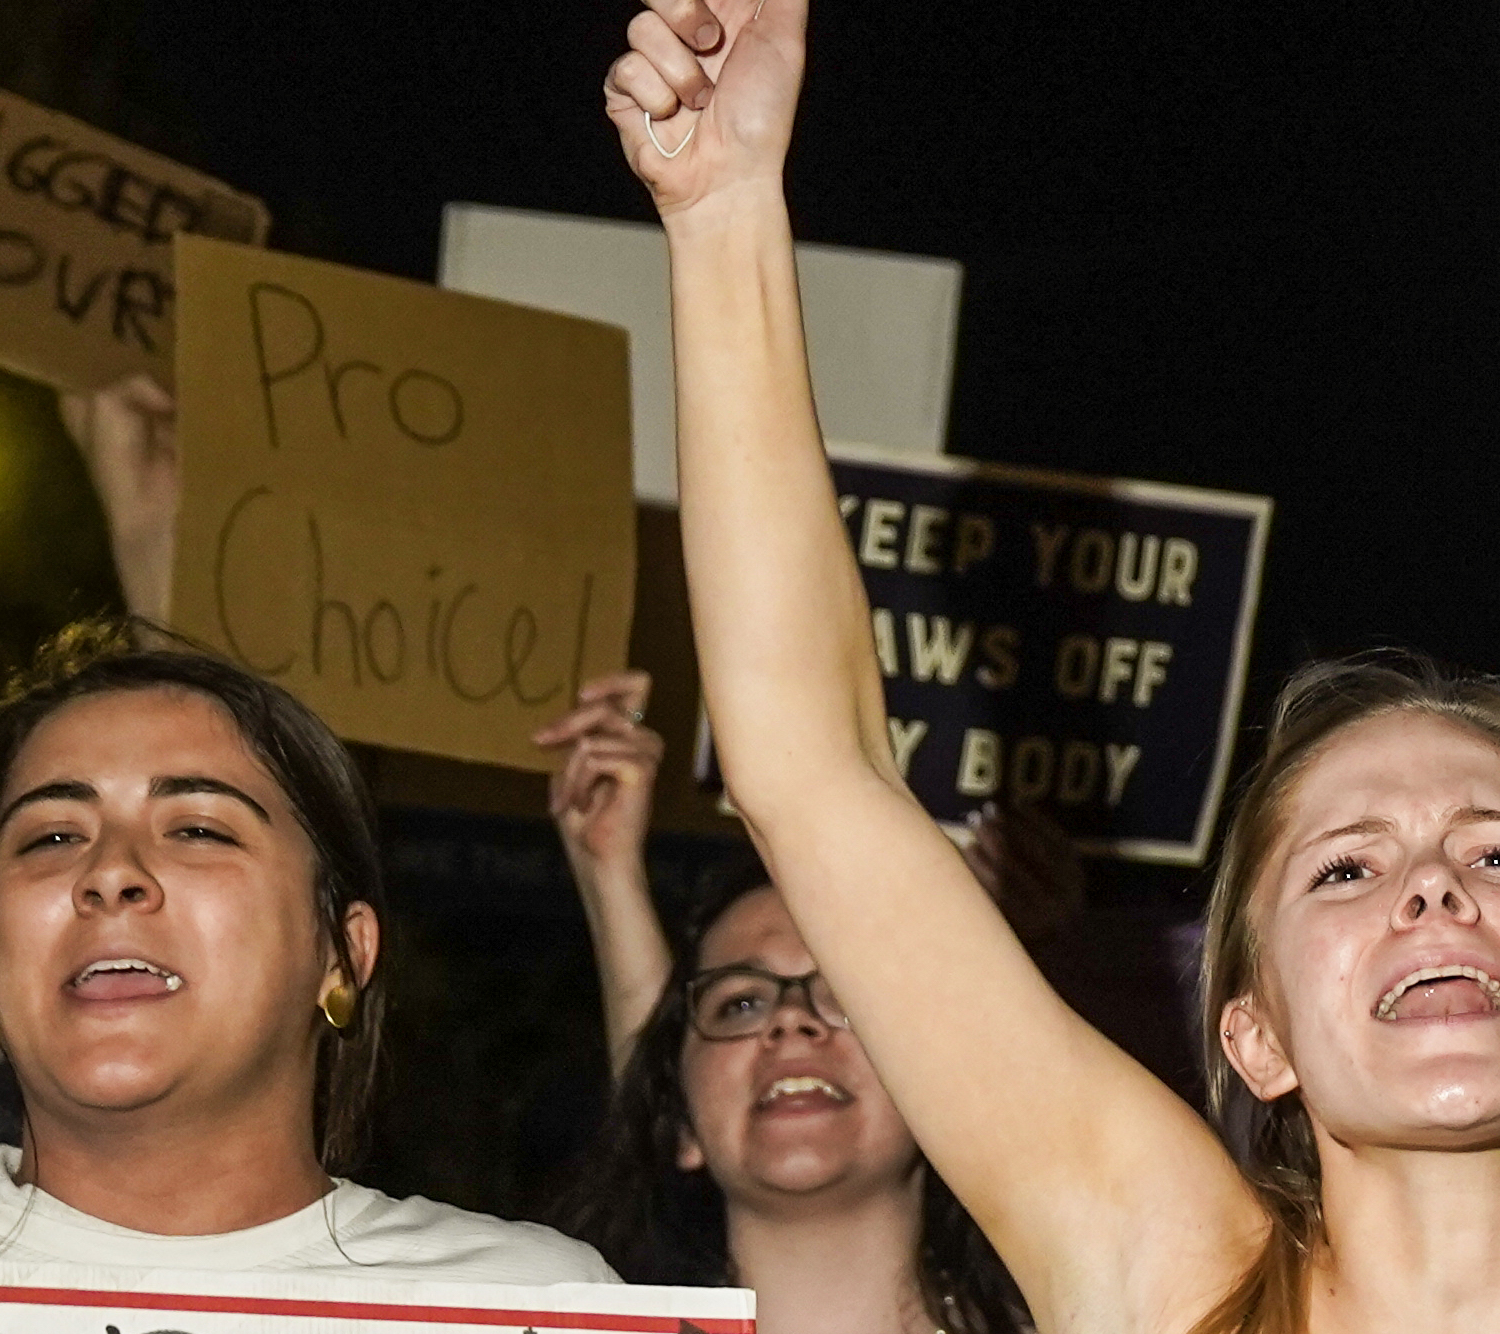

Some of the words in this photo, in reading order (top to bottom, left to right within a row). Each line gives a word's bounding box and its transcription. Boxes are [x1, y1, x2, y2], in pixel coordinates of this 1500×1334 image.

[247, 281, 465, 449] Pro
[838, 495, 994, 577] EEP
[1027, 522, 1200, 608] YOUR
[871, 608, 1021, 691] AWS
[1053, 633, 1173, 707] OFF
[955, 725, 1142, 807] BODY
